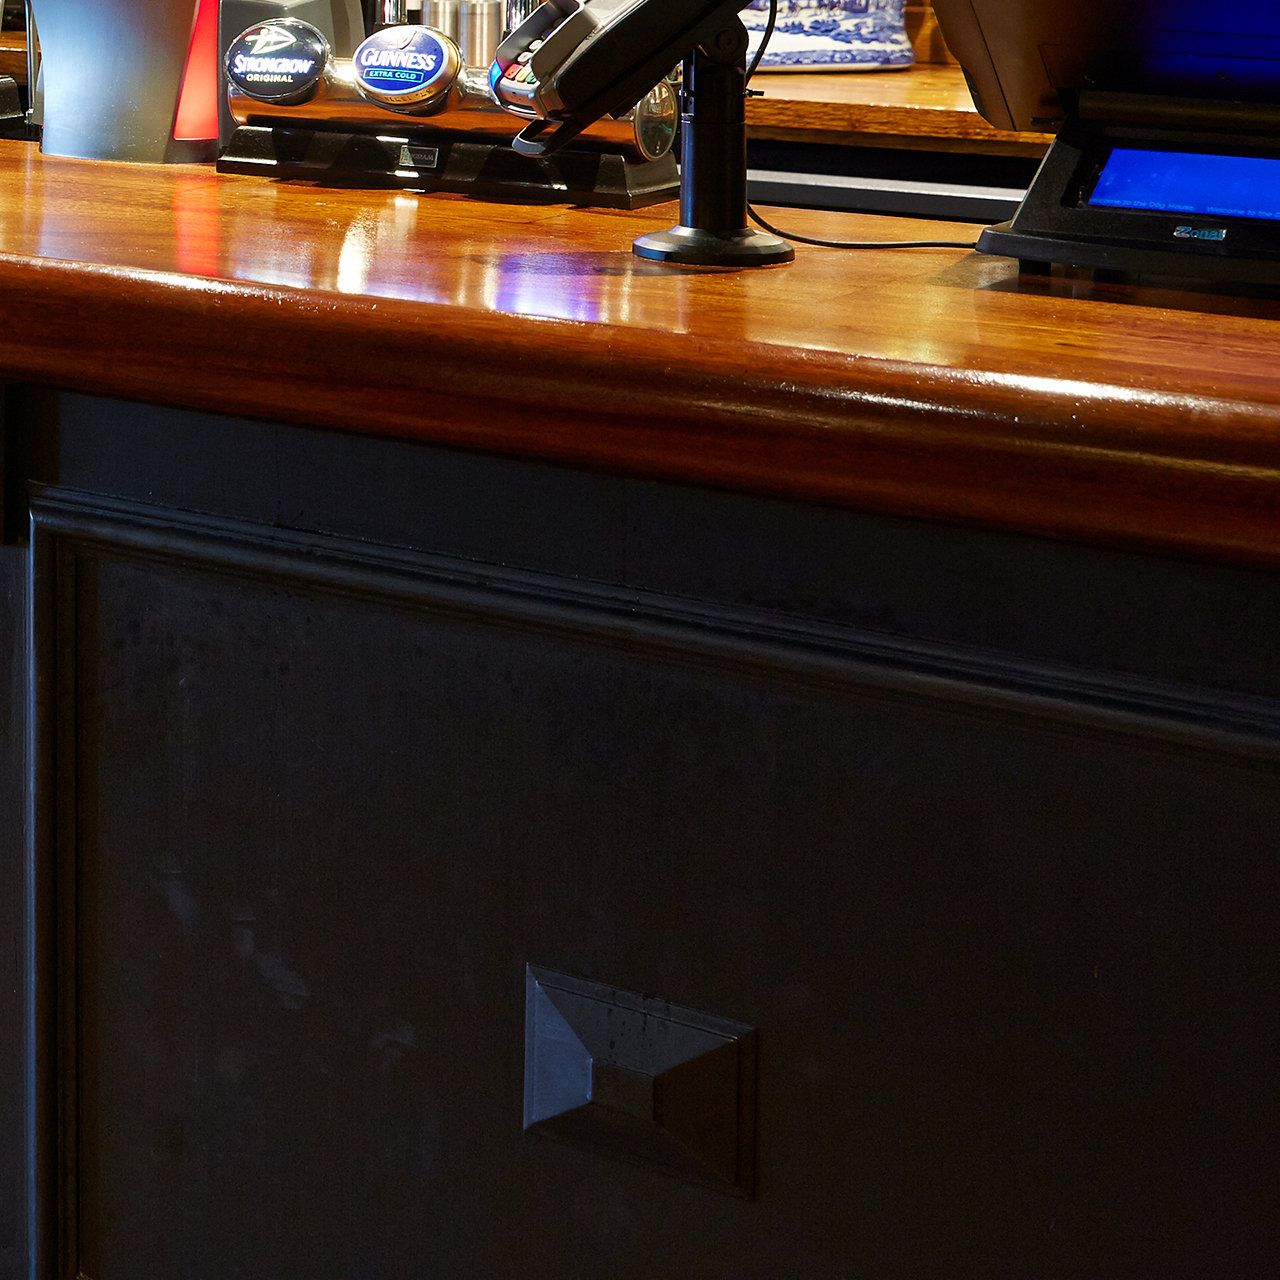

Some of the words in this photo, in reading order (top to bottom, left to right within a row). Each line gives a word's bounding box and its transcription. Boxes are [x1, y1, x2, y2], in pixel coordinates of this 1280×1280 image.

[233, 54, 313, 73] STRONGBOW
[360, 48, 437, 71] GUINNESS
[246, 74, 294, 83] ORIGINAL
[395, 72, 417, 80] COLD
